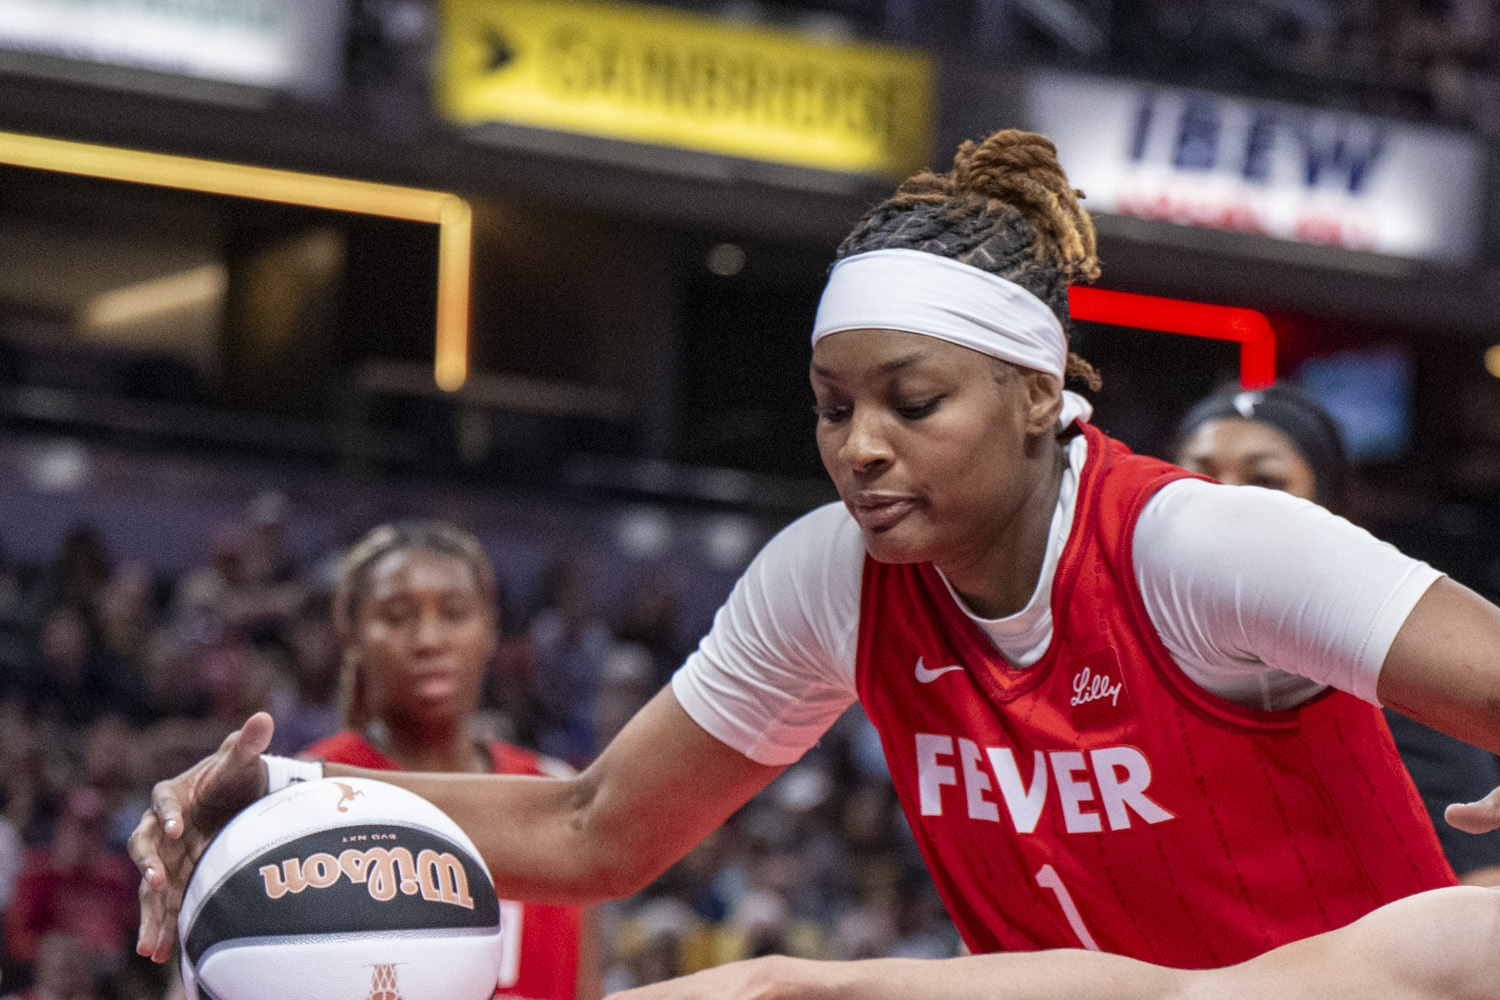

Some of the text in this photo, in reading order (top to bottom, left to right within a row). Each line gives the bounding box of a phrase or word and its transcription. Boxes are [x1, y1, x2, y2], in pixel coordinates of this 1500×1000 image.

[1070, 666, 1122, 707] Lilly
[915, 733, 1177, 834] FEVER
[341, 833, 368, 843] NXT
[259, 846, 475, 910] Wilson
[1034, 863, 1101, 952] 1
